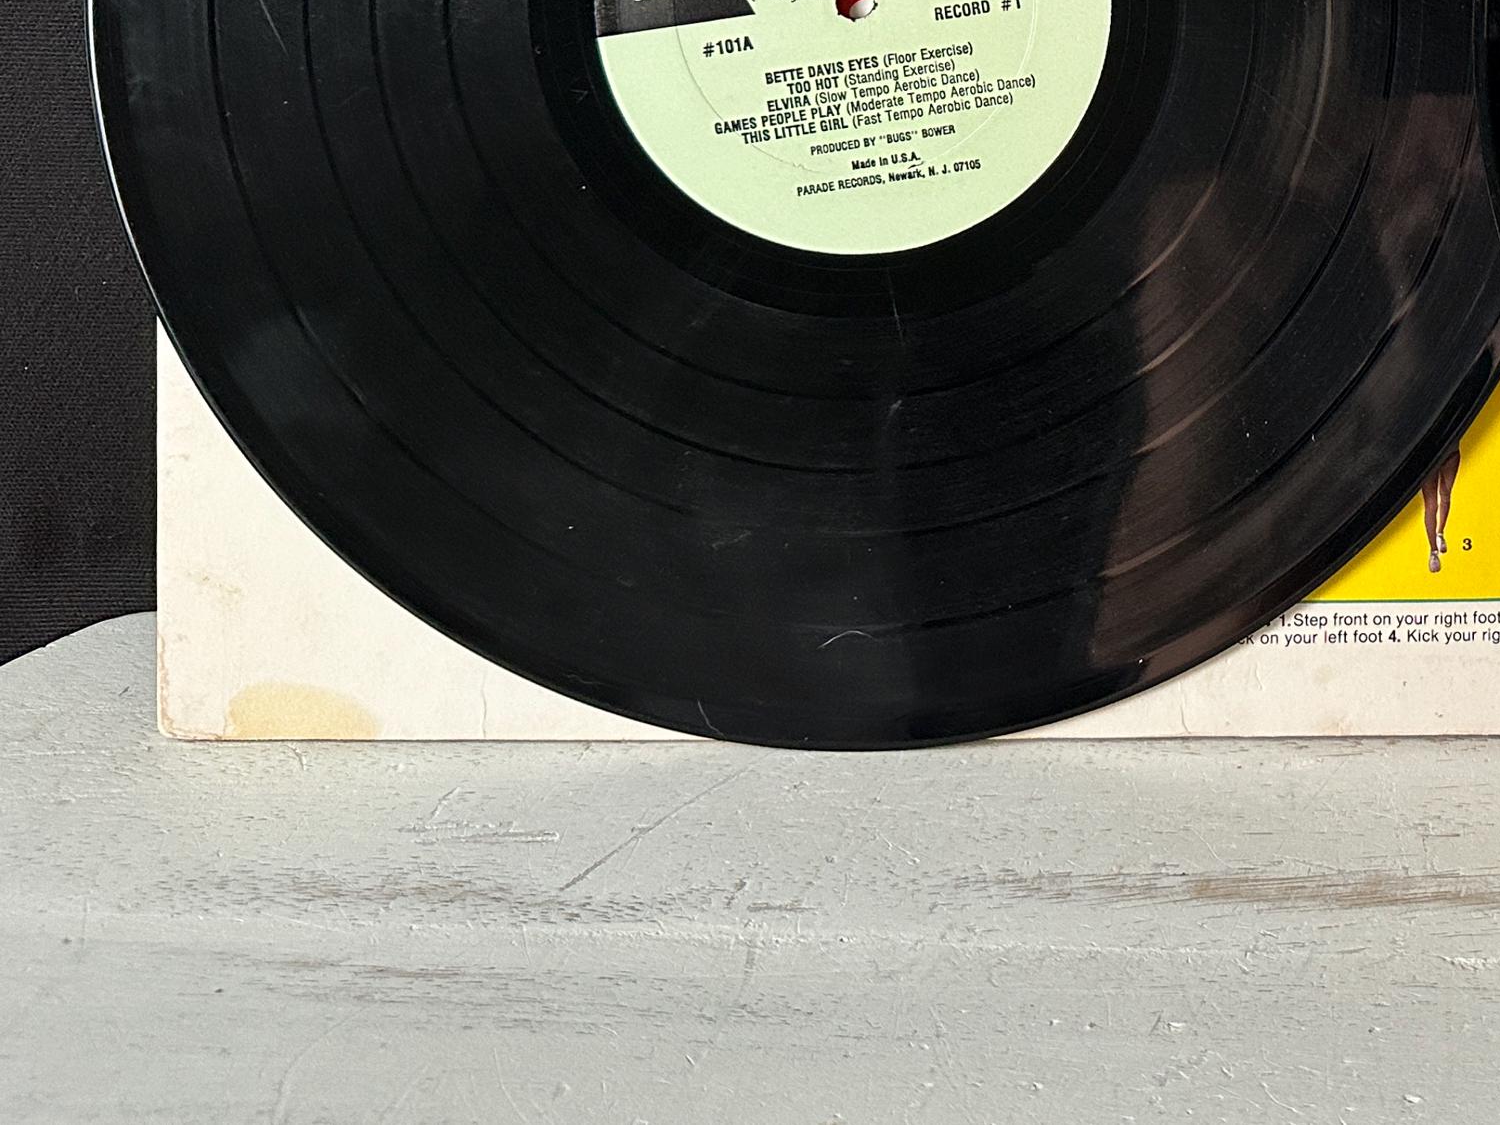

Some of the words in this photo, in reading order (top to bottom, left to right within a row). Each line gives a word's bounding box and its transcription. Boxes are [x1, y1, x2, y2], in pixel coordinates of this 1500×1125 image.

[934, 0, 990, 21] RECORD
[703, 36, 754, 57] #101A
[765, 67, 804, 84] BETTE
[808, 62, 844, 77] DAVIS
[848, 56, 879, 71] EYES
[883, 51, 917, 68] (Floor
[921, 42, 973, 60] Exercise)
[787, 81, 811, 95] TOO
[816, 76, 839, 90] HOT
[844, 68, 899, 88] (Standing
[903, 59, 955, 77] Exercise)
[714, 117, 757, 134] GAMES
[761, 110, 807, 128] PEOPLE
[811, 104, 841, 119] PLAY
[847, 95, 904, 116] (Moderate
[907, 90, 946, 106] Tempo
[951, 81, 993, 98] Aerobic
[997, 74, 1036, 90] Dance)
[767, 95, 811, 112] ELVIRA
[815, 90, 847, 108] (Slow
[852, 83, 890, 101] Tempo
[894, 75, 937, 93] Aerobic
[941, 69, 980, 85] Dance)
[742, 129, 770, 144] THIS
[774, 122, 816, 140] LITTLE
[821, 117, 848, 132] GIRL
[853, 112, 882, 129] (Fast
[885, 108, 924, 122] Tempo
[928, 99, 970, 116] Aerobic
[975, 92, 1013, 108] Dance)
[810, 139, 861, 156] PRODUCED
[864, 137, 876, 147] BY
[922, 125, 955, 138] BOWER
[852, 159, 876, 170] Made
[891, 151, 921, 164] U.S.A.
[797, 182, 835, 196] PARADE
[838, 174, 885, 190] RECORDS,
[888, 168, 925, 182] Newark,
[929, 166, 938, 177] N.
[942, 164, 951, 173] J.
[954, 159, 981, 172] 07105
[1463, 539, 1472, 550] 3
[1333, 613, 1368, 626] front
[1373, 615, 1391, 625] on
[1396, 614, 1429, 628] your
[1435, 612, 1468, 627] right
[1473, 611, 1500, 624] foot
[1260, 633, 1279, 644] on
[1285, 633, 1318, 647] your
[1324, 630, 1348, 643] left
[1353, 630, 1382, 643] foot
[1389, 630, 1401, 643] 4.
[1407, 629, 1440, 643] Kick
[1445, 630, 1477, 644] your
